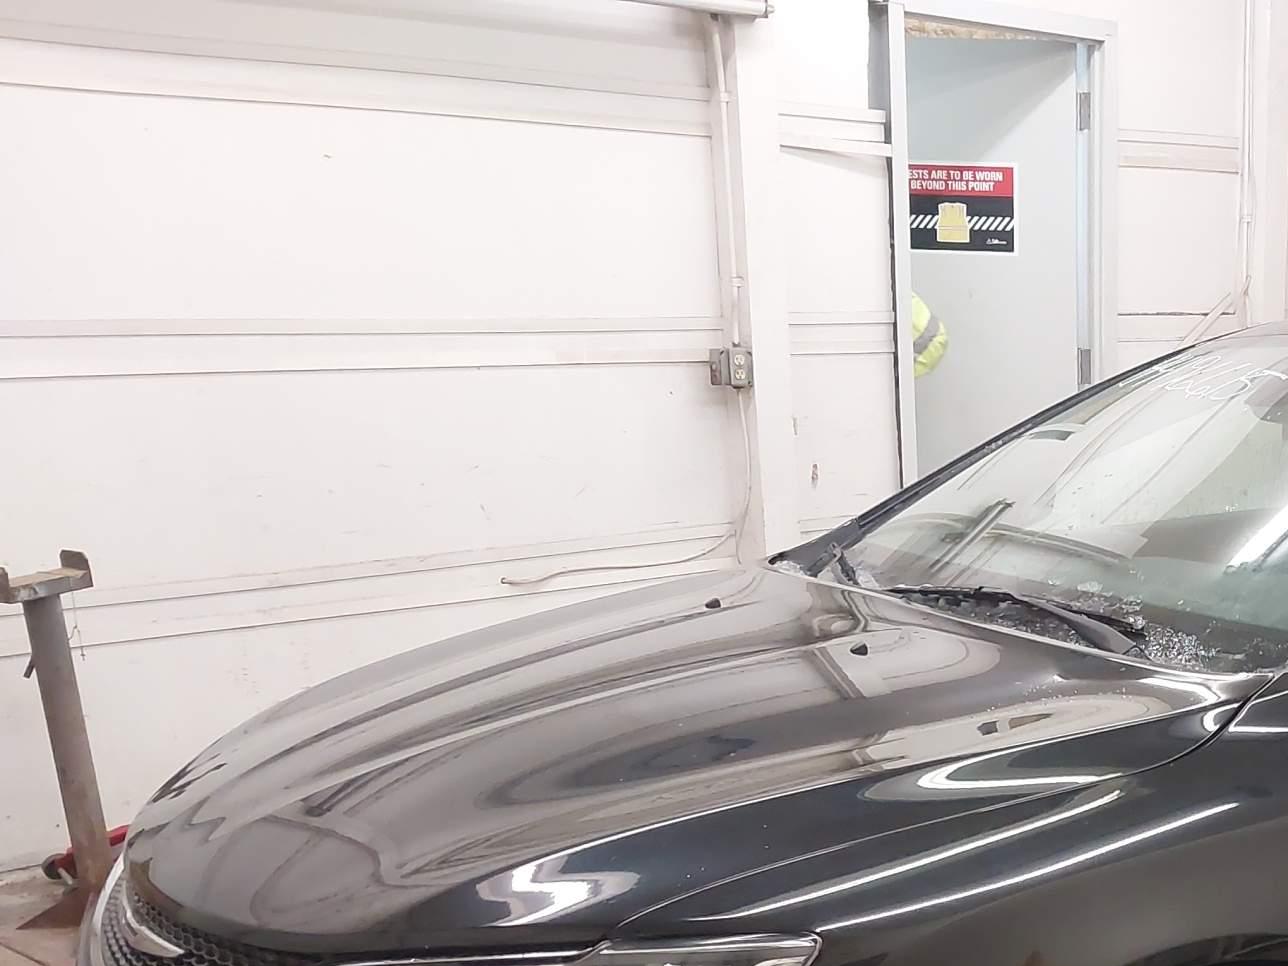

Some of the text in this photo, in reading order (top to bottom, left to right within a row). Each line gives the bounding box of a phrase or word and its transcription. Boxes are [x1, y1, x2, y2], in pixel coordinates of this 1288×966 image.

[931, 170, 947, 179] ARE
[949, 170, 960, 180] TO
[963, 171, 975, 180] BE
[975, 171, 1003, 181] WORN
[911, 180, 995, 191] BEYOND THIS POINT
